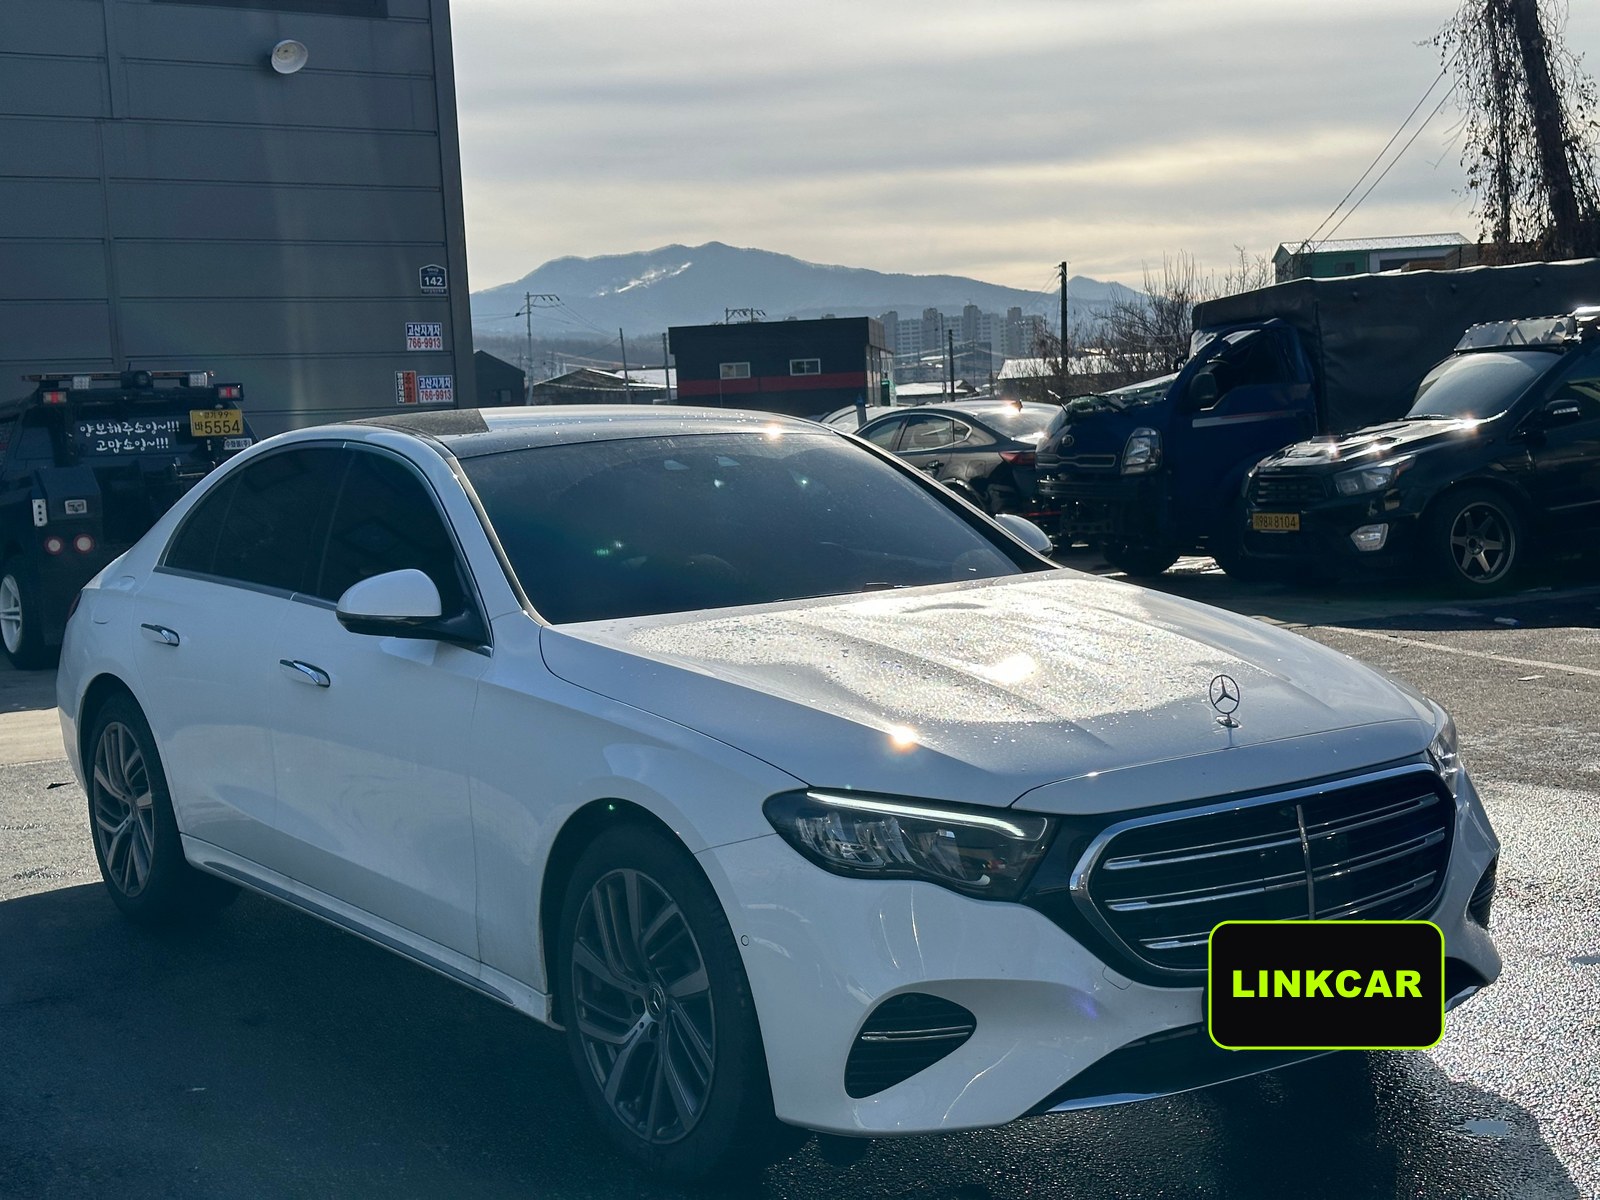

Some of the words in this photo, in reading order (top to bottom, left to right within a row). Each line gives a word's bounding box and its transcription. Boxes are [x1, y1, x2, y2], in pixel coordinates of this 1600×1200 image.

[424, 276, 443, 286] 142
[407, 324, 440, 336] 고산지게차
[408, 337, 441, 349] 766-9913
[420, 376, 451, 389] 고산지게차
[420, 389, 452, 401] 766-9913
[194, 420, 240, 434] 바5554
